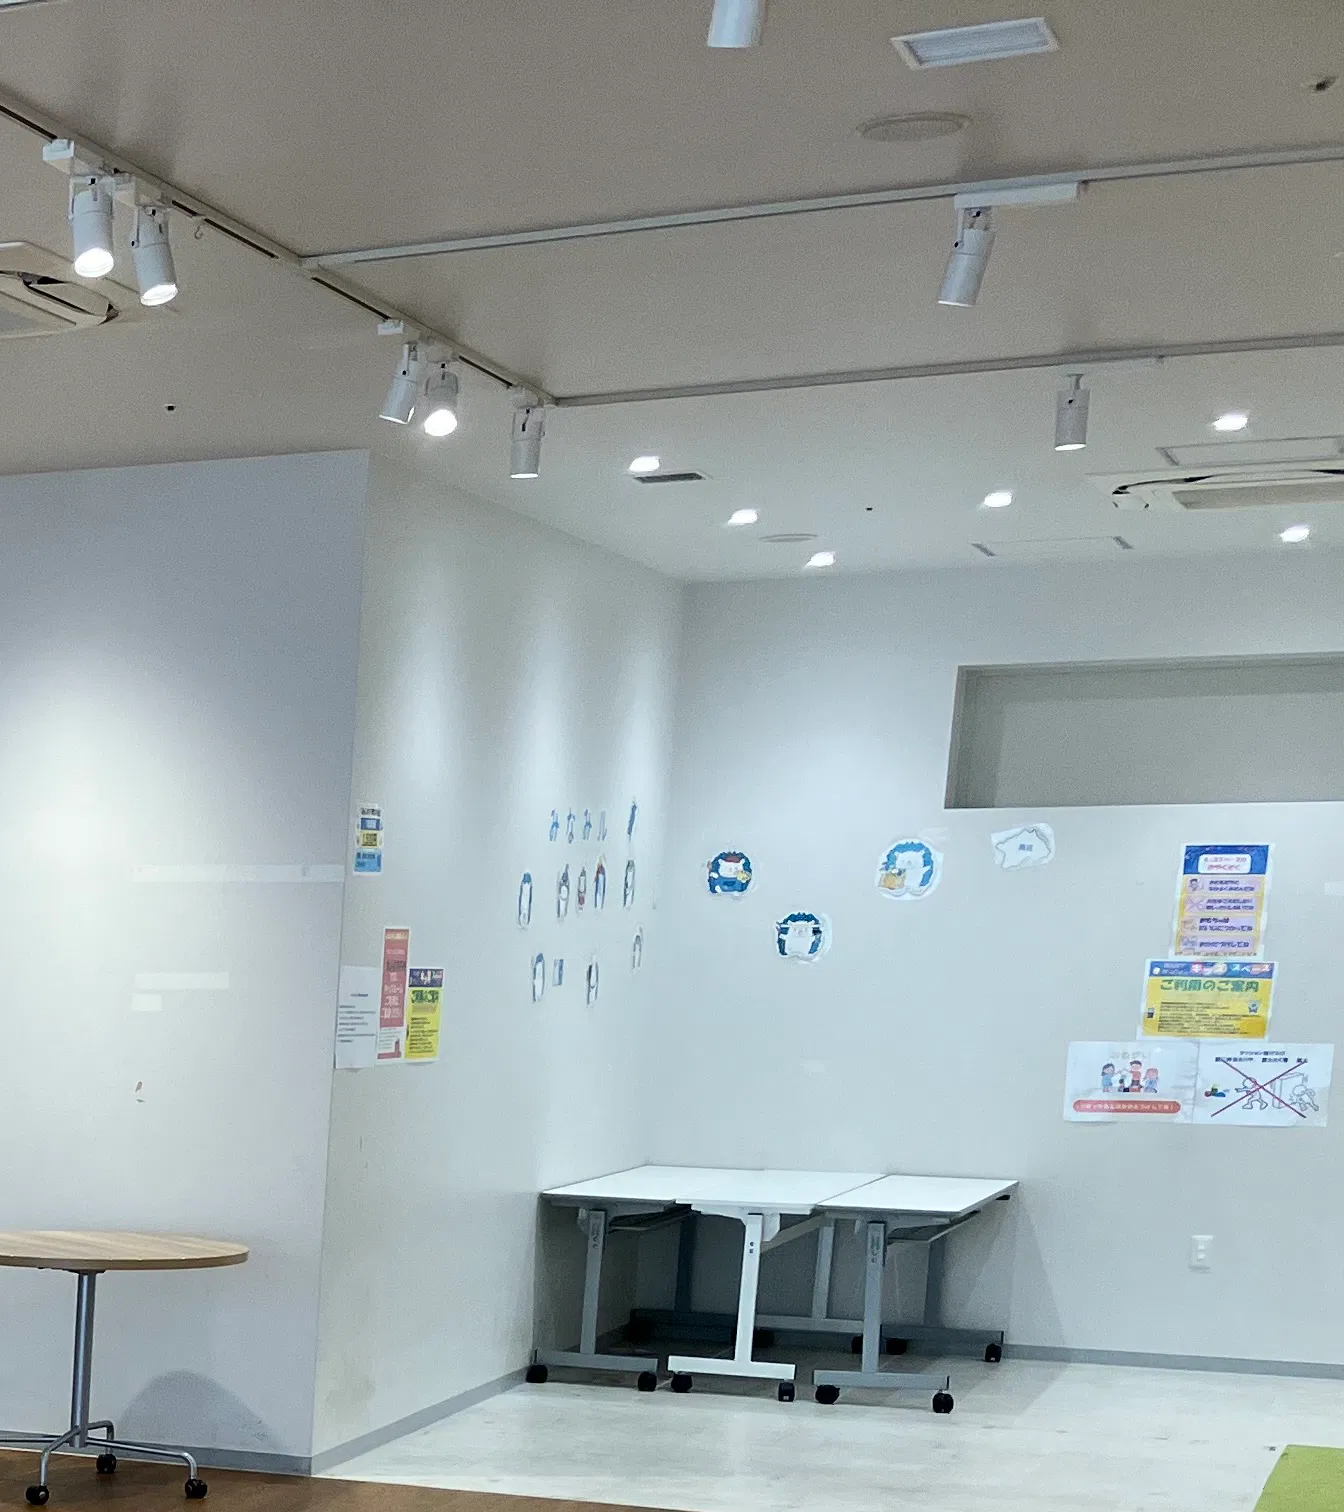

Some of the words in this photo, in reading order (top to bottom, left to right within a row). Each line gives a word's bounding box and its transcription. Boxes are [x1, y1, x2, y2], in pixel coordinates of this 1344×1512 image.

[1160, 979, 1260, 992] ご利用のご案内
